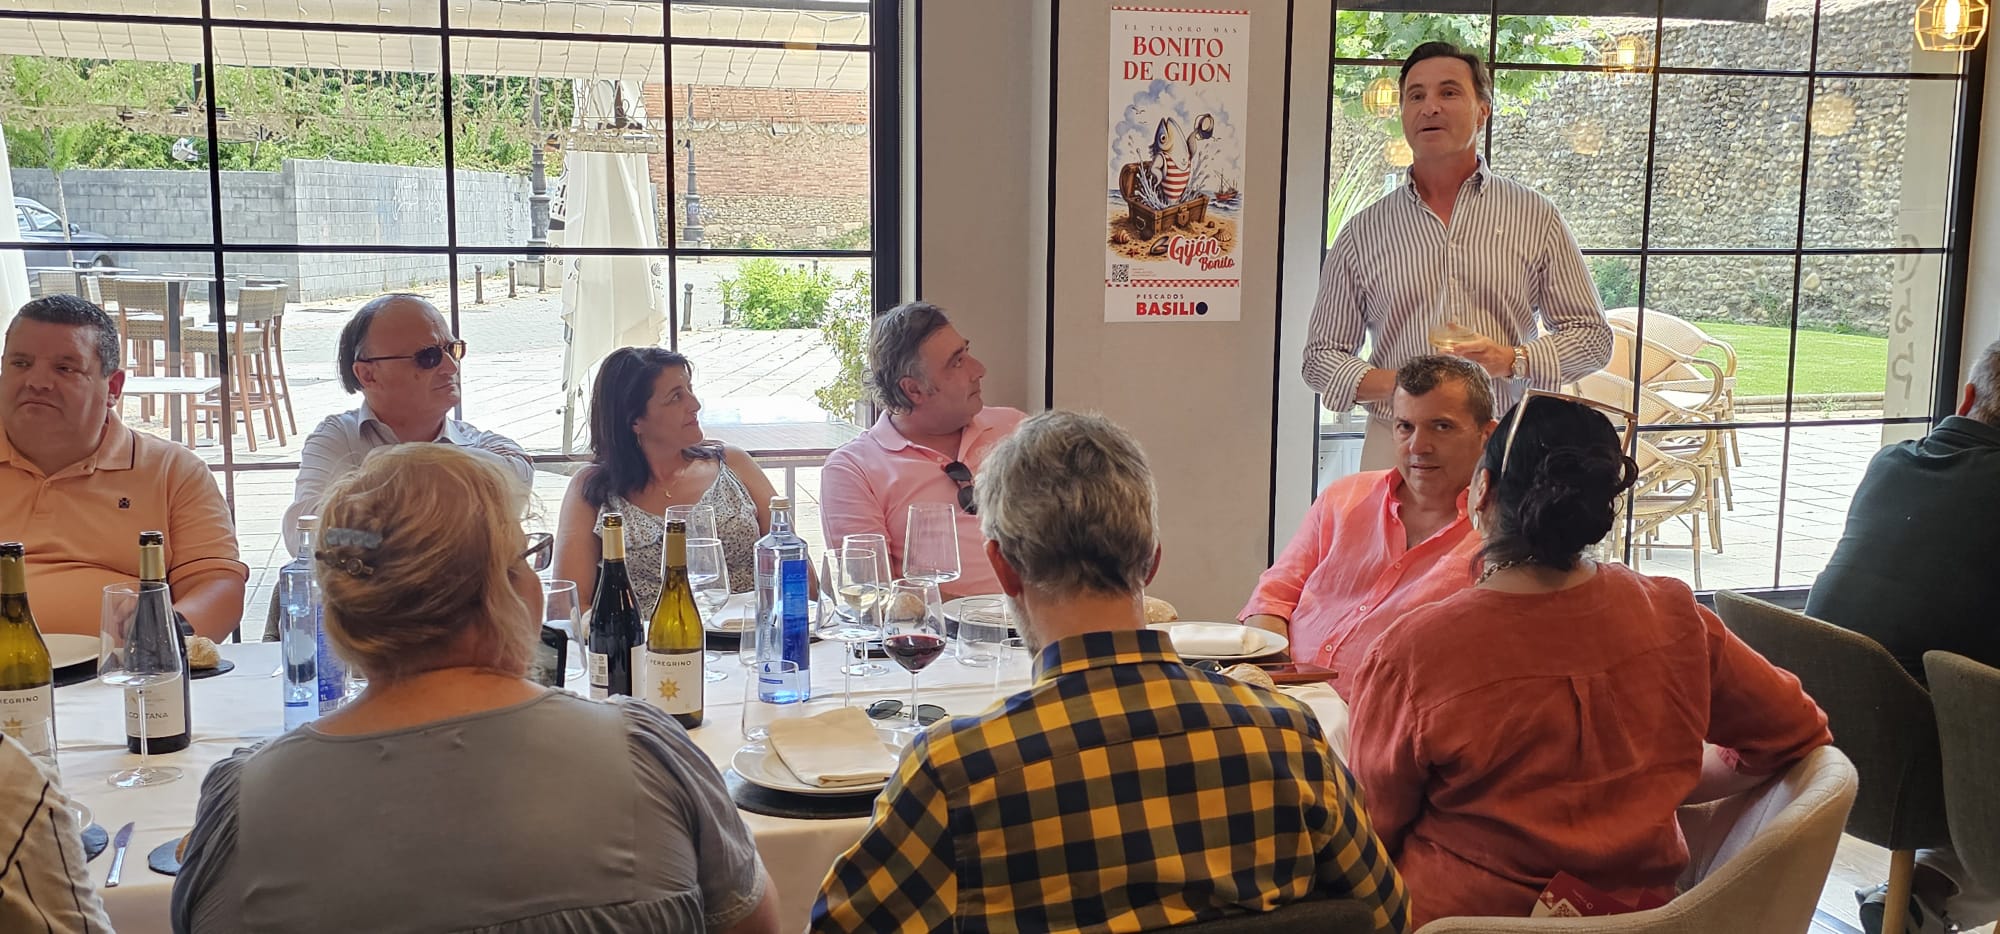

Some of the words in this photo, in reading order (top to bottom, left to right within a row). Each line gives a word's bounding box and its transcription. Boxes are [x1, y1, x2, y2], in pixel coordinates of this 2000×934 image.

[1151, 25, 1201, 33] TESORO
[1134, 36, 1223, 57] BONITO
[1123, 61, 1153, 81] DE
[1164, 59, 1231, 86] GIJÓN
[1169, 235, 1220, 266] Gijón
[1198, 256, 1235, 271] Bonito
[1136, 301, 1208, 315] BASILIO
[650, 659, 692, 667] PEREGRINO
